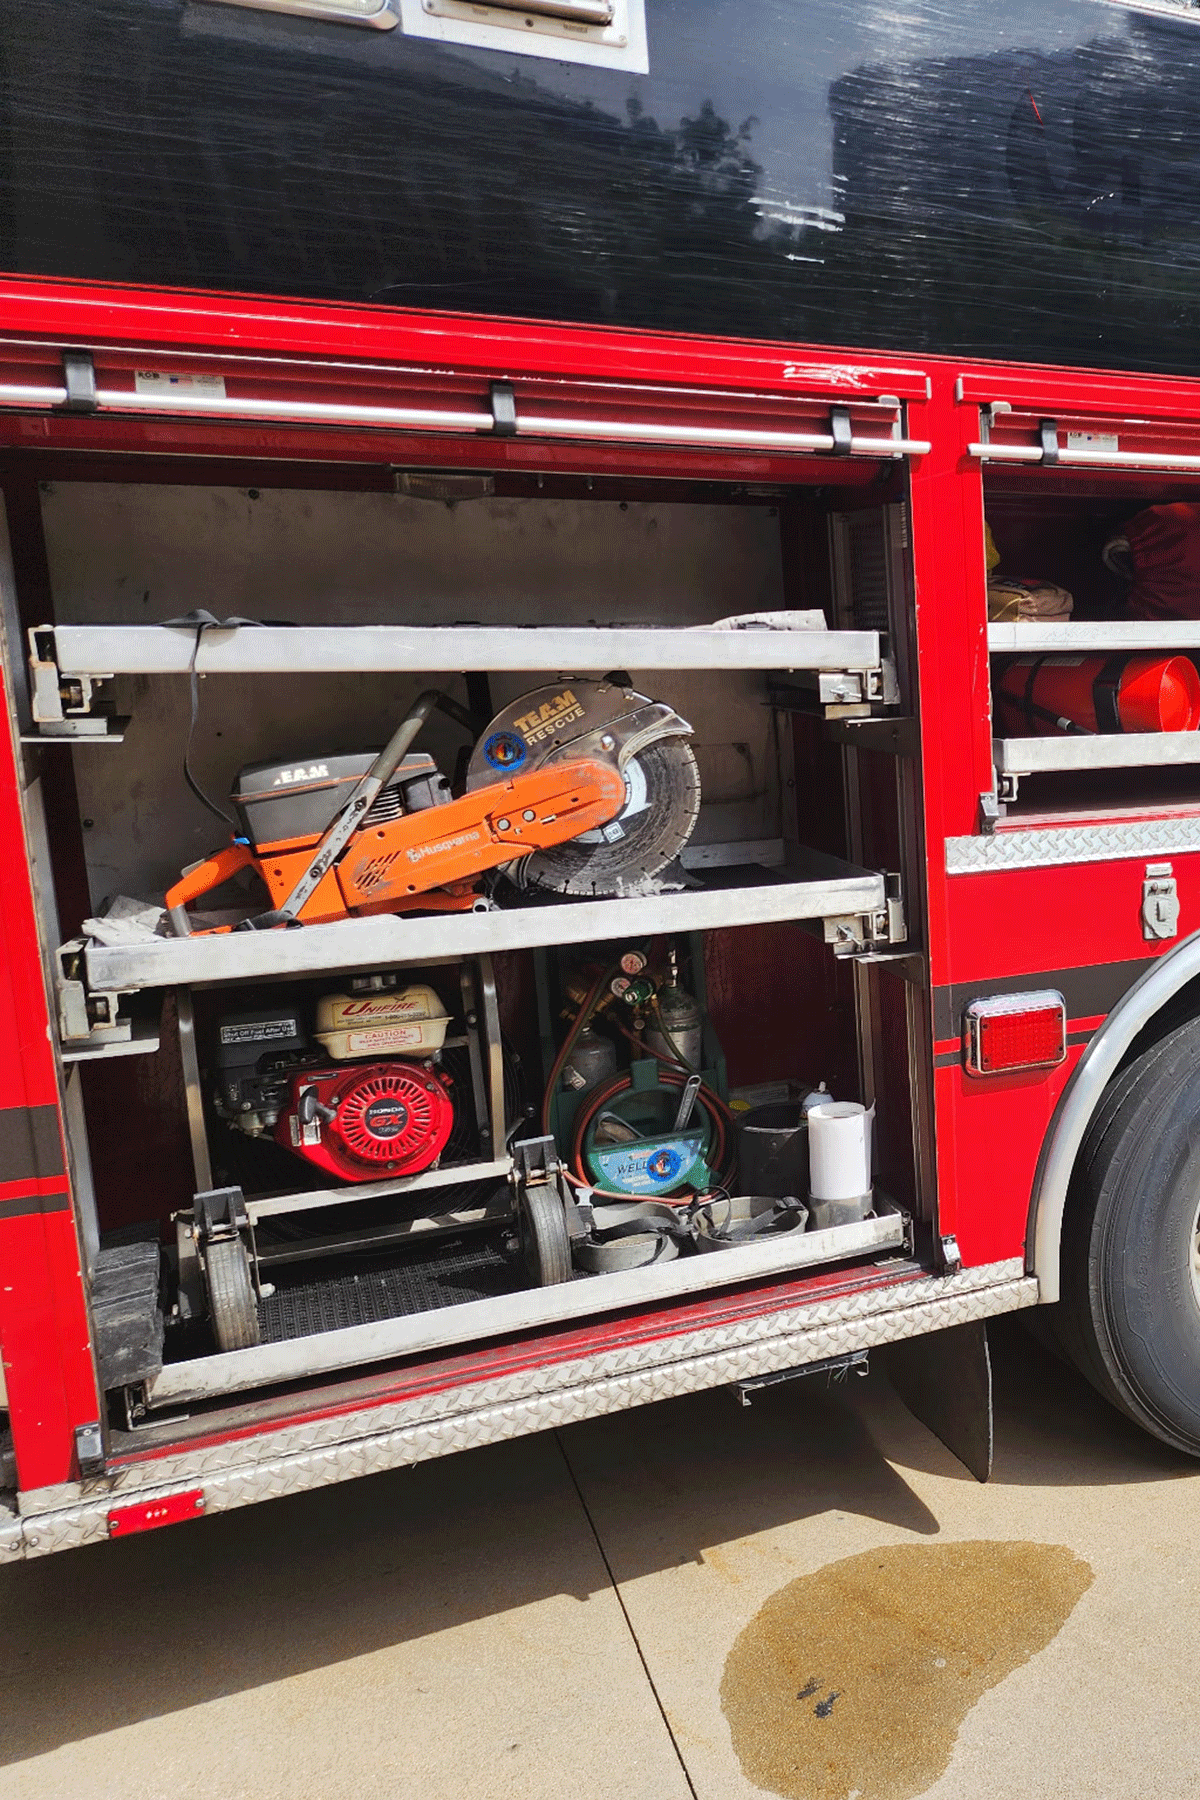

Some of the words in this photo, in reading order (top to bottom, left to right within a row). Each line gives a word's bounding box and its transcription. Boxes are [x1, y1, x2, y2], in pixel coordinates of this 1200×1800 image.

[513, 689, 579, 733] TEAM
[525, 706, 587, 747] RESCUE
[418, 829, 481, 859] Husqvarna
[364, 1029, 407, 1040] CAUTION
[369, 1107, 405, 1116] HONDA
[369, 1113, 404, 1128] GX
